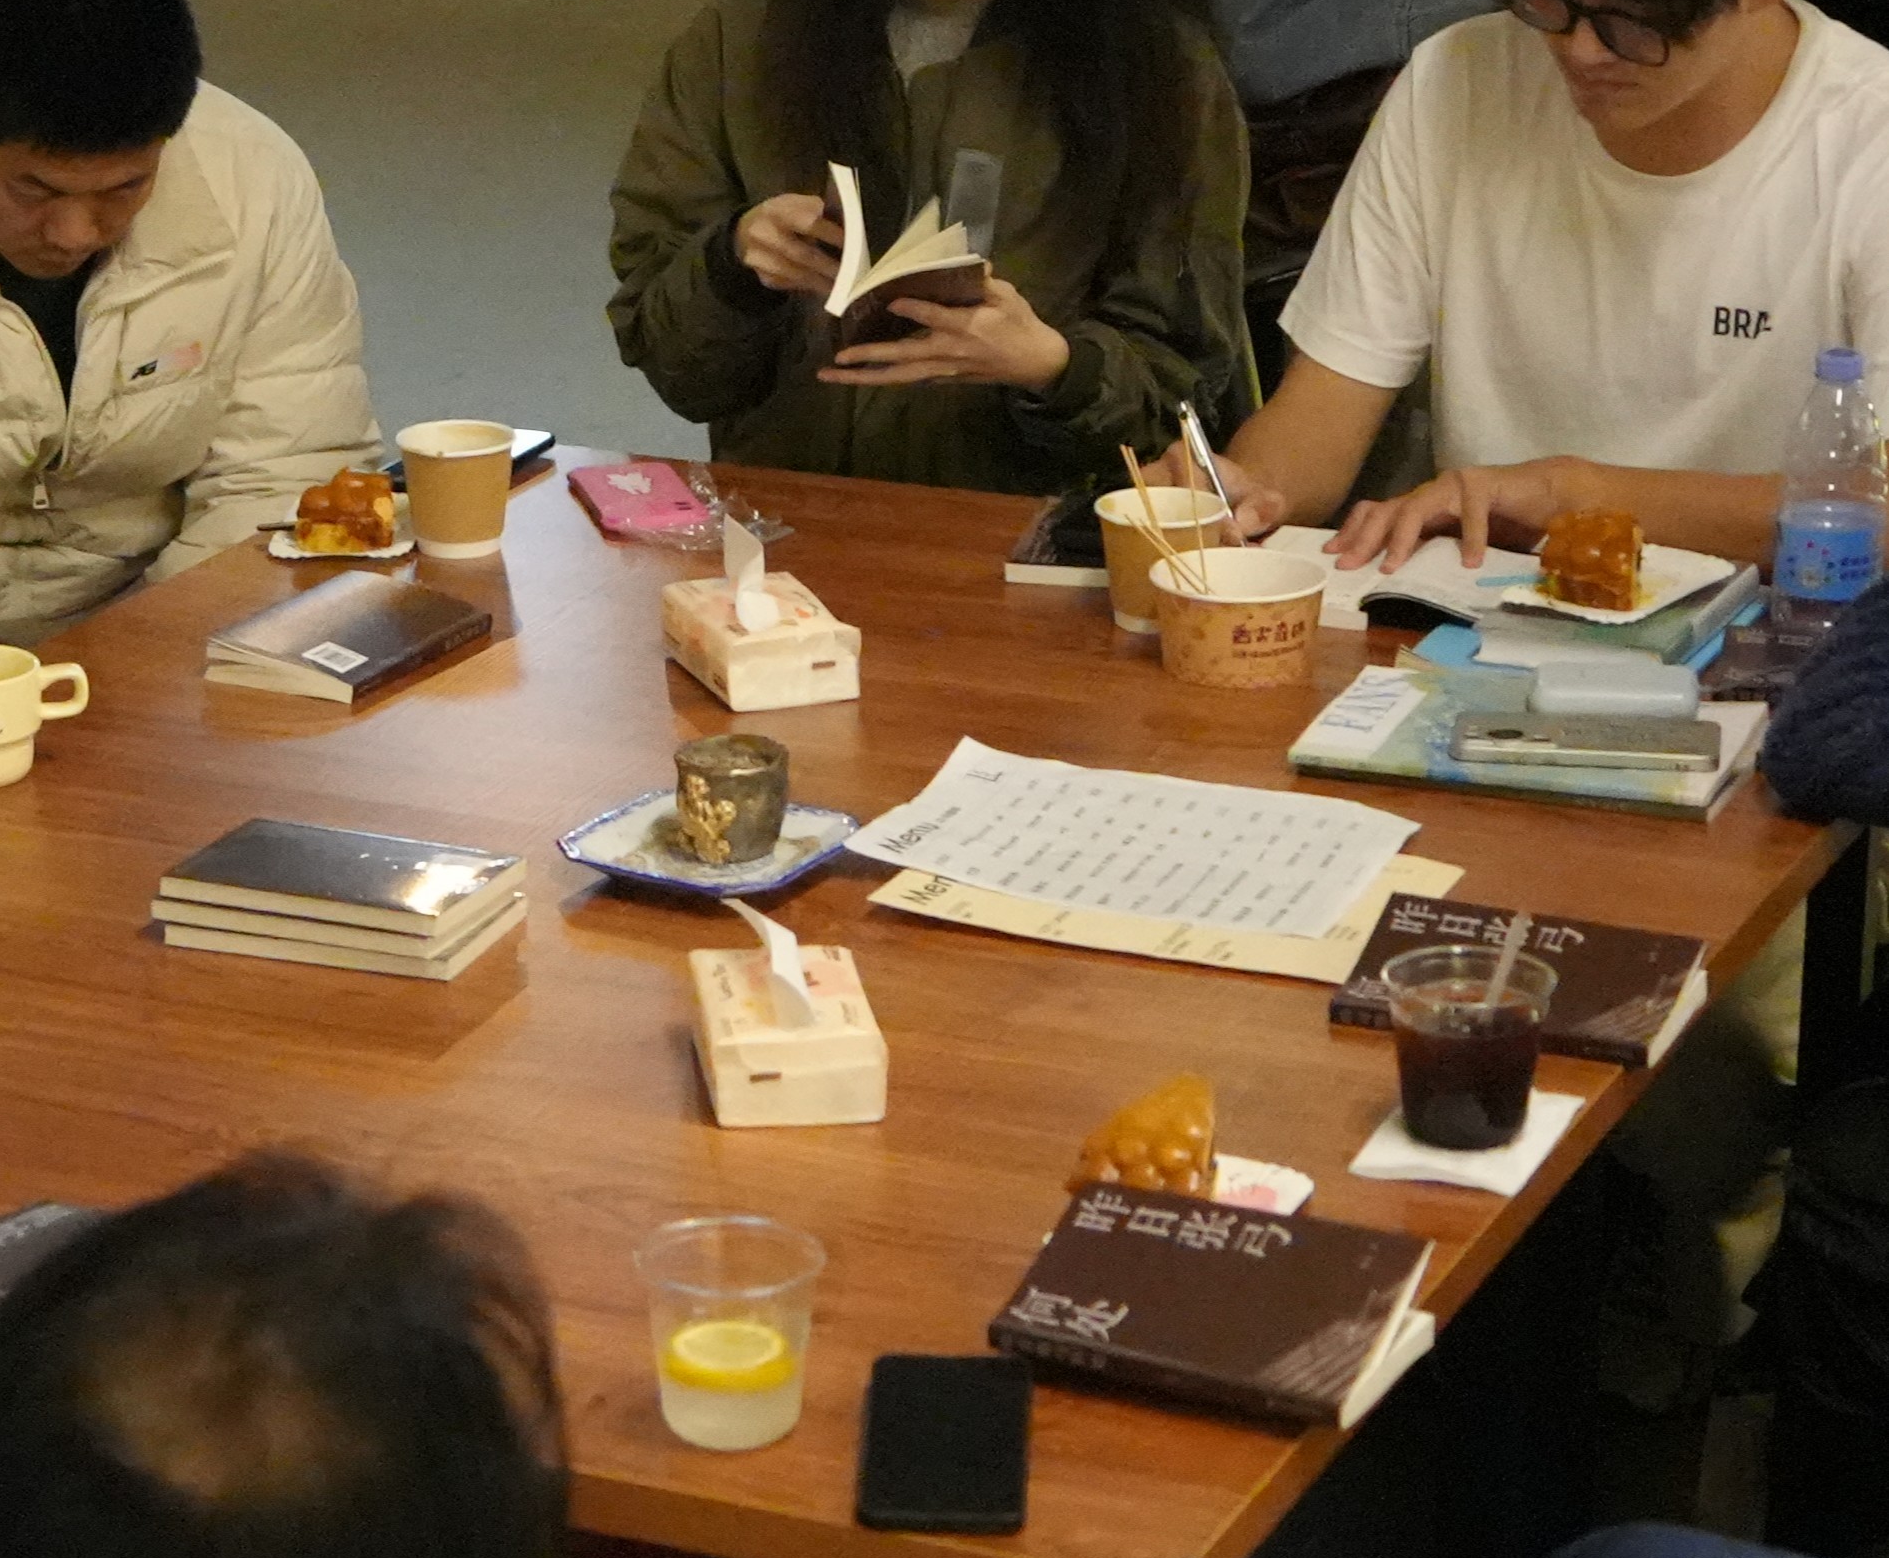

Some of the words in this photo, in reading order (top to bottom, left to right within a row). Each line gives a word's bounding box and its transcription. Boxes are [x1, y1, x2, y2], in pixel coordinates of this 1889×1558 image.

[878, 821, 940, 854] Menu
[899, 874, 959, 906] Men
[1073, 1189, 1293, 1258] 昨日张弓
[1010, 1285, 1130, 1342] 何处
